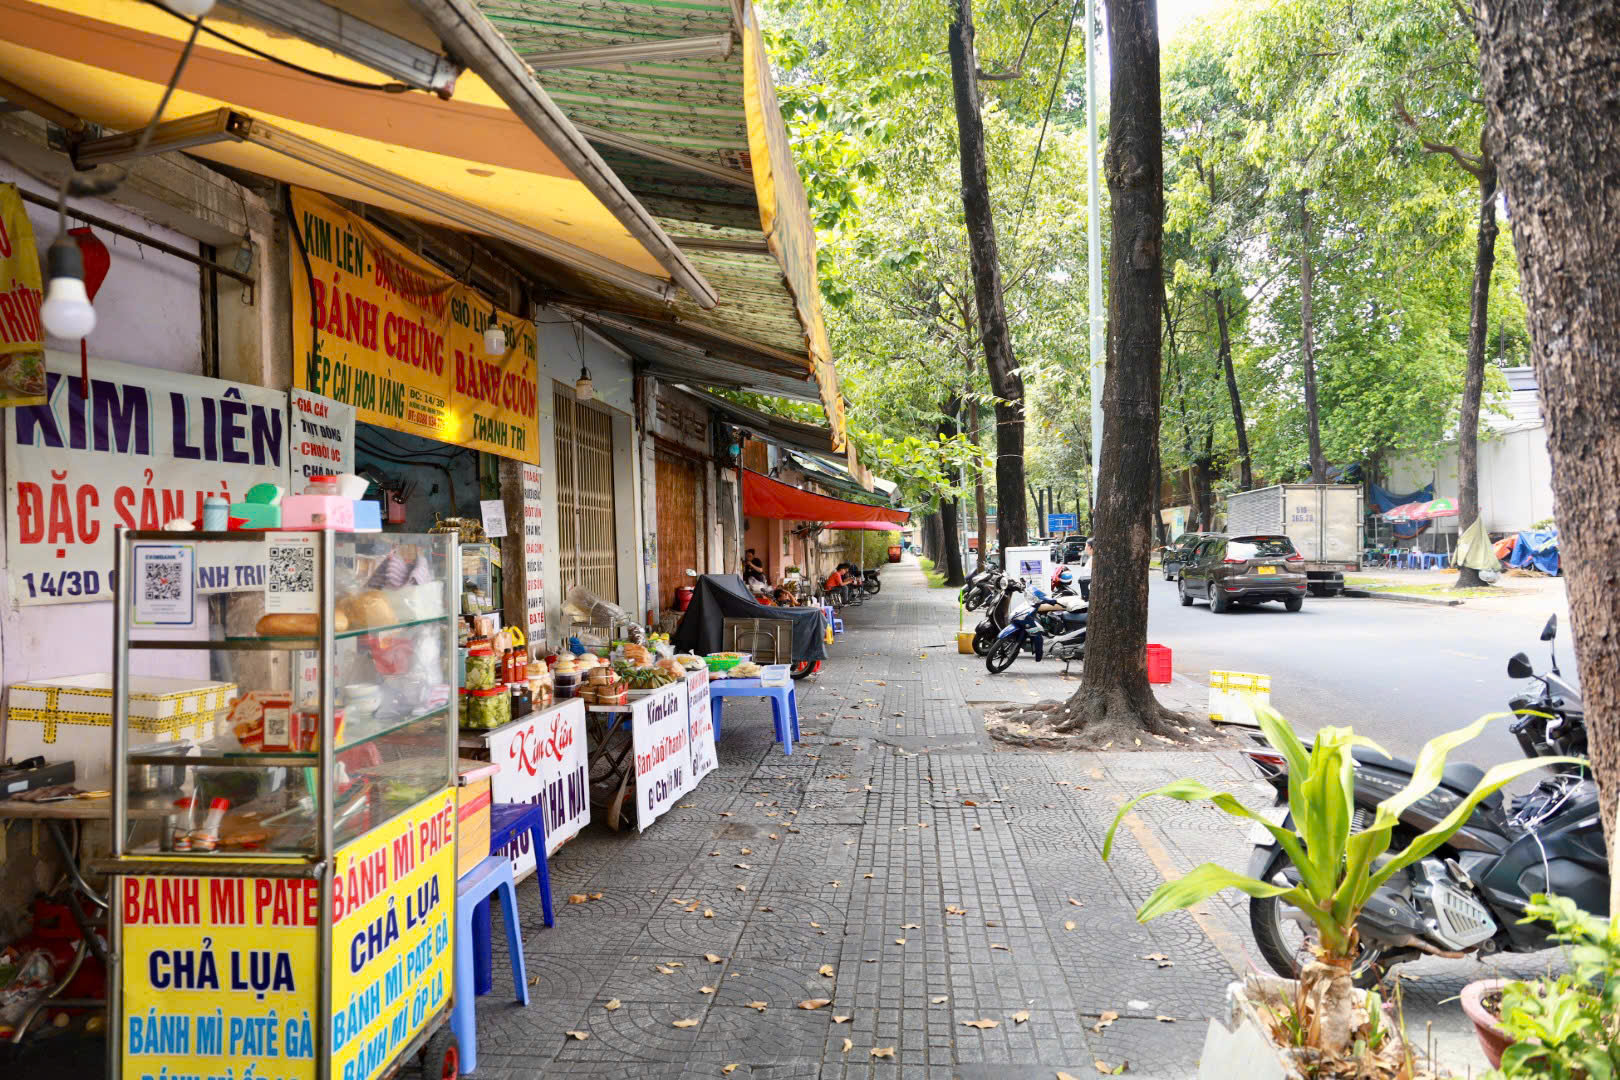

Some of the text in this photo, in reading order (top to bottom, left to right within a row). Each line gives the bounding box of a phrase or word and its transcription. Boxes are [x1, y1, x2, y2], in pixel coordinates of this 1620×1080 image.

[304, 210, 332, 263] KIM
[309, 271, 378, 352] BÁNH
[16, 371, 283, 467] KIM LIÊN
[333, 352, 352, 405] CÁI
[353, 367, 376, 412] HOA
[378, 367, 405, 419] VÀNG
[455, 343, 537, 420] BÁNH CUỐN
[474, 413, 526, 452] THANH TRÌ
[17, 469, 100, 558] ĐẶC
[114, 468, 184, 531] SẢN
[23, 570, 100, 598] 14/3D
[509, 724, 544, 777] Kim
[332, 846, 387, 925] BÁNH
[393, 822, 416, 882] MÌ
[419, 798, 453, 863] PATÊ
[350, 873, 440, 974] CHẢ LỤA
[149, 936, 296, 1000] CHẢ LỤA
[333, 911, 449, 1054] BÁNH MÌ PATÊ GÀ
[129, 1007, 314, 1059] BÁNH MÌ PATÊ GÀ
[390, 998, 409, 1052] MÌ
[431, 968, 443, 1010] LA
